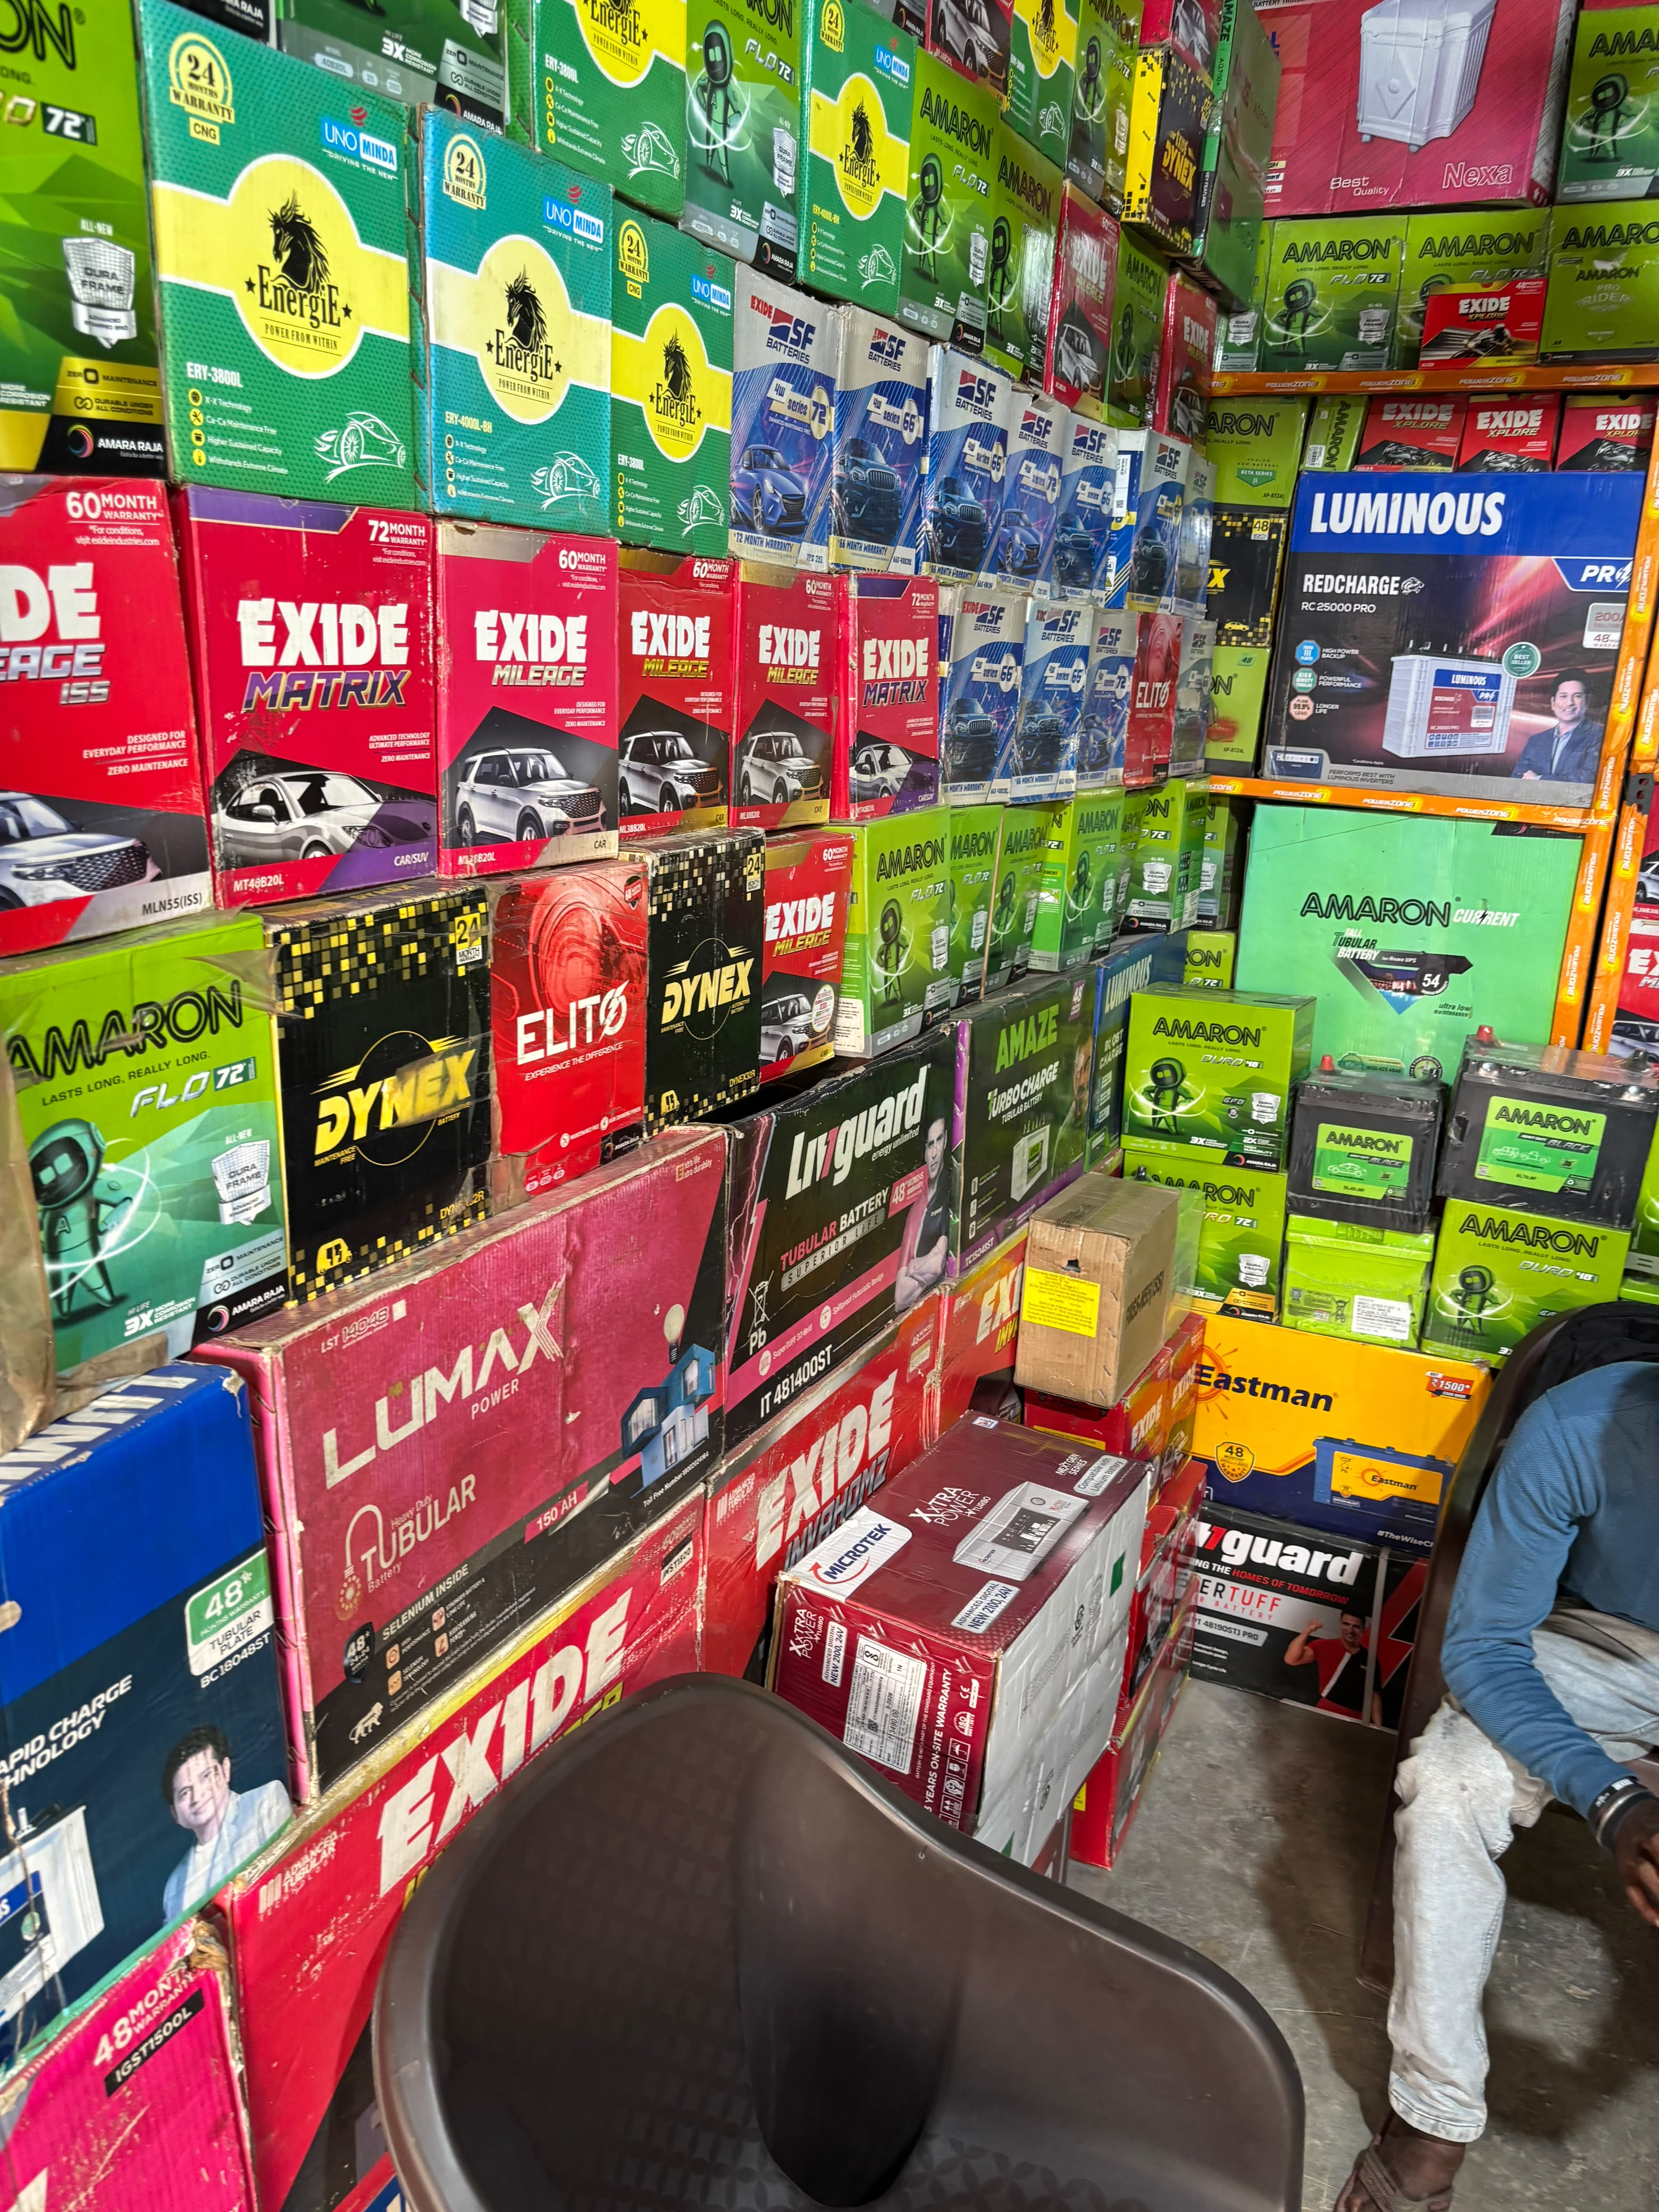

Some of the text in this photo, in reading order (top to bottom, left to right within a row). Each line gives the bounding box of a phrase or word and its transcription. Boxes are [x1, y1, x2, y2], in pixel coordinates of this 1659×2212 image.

[187, 52, 215, 86] 24
[188, 80, 219, 99] MONTHS
[171, 88, 234, 122] WARRANTY
[193, 123, 217, 140] CNG
[920, 88, 992, 161] AMARON
[325, 123, 395, 166] UNO MINDA
[1330, 175, 1369, 190] Best
[1443, 163, 1513, 189] Nexa
[1353, 185, 1389, 197] Quality
[80, 220, 113, 236] ALL-NEW
[1283, 238, 1391, 264] AMARON
[81, 280, 125, 295] FRAME
[85, 266, 118, 282] DURA
[751, 295, 772, 319] EXIDE
[1459, 297, 1510, 315] EXIDE
[265, 324, 338, 350] POWER FROM WITHIN
[766, 338, 810, 364] BATTERIES
[103, 375, 157, 387] MAINTENANCE
[187, 362, 243, 389] ERY-3800L
[1459, 375, 1516, 385] POWERZONE
[975, 374, 996, 407] SF
[219, 397, 252, 414] Technology
[787, 398, 807, 416] series
[957, 397, 993, 420] BATTERIES
[226, 419, 263, 433] Maintenance
[265, 425, 277, 435] Free
[445, 411, 492, 434] ERY-4000L-BH
[1477, 409, 1543, 430] EXIDE
[1487, 426, 1538, 438] XPLORE
[98, 438, 163, 454] AMARA RAJA
[208, 435, 282, 456] Higher Sustained Capacity
[1323, 400, 1352, 468] AMARON
[208, 455, 288, 474] Withstands Extreme Climate
[66, 492, 156, 520] 60 MONTH
[1310, 492, 1506, 535] LUMINOUS
[106, 527, 144, 537] conditions,
[1254, 522, 1268, 531] 48
[91, 537, 160, 546] exideindustries.com
[744, 534, 793, 552] MONTH WARRANTY
[559, 549, 605, 569] 60 MONTH
[1303, 575, 1401, 595] REDCHARGE
[1302, 602, 1376, 614] RC 25000 PRO
[237, 599, 408, 666] EXIDE
[474, 609, 587, 663] EXIDE
[631, 611, 710, 658] EXIDE
[758, 625, 820, 667] EXIDE
[642, 659, 709, 678] MILEAGE
[862, 638, 928, 680] EXIDE
[491, 665, 586, 686] MILEAGE
[61, 681, 110, 705] ISS
[242, 671, 411, 711] MATRIX
[862, 680, 928, 707] MATRIX
[83, 740, 186, 759] EVERYDAY PERFORMANCE
[127, 731, 186, 744] DESIGNED FOR
[108, 759, 188, 775] ZERO MAINTENANCE
[1358, 776, 1394, 785] INVERTERS
[1363, 798, 1414, 808] POWERZONE
[594, 839, 606, 849] CAR
[394, 852, 429, 866] CAR/SUV
[876, 841, 944, 882] AMARON
[233, 875, 284, 892] MT40B20L
[142, 892, 202, 916] MLN55(ISS)
[765, 892, 835, 941] EXIDE
[1300, 892, 1451, 927] AMARON
[772, 930, 832, 957] MILEAGE
[1337, 948, 1380, 960] BATTERY
[661, 958, 755, 1024] DYNEX
[1104, 954, 1153, 1013] LUMINOUS
[1422, 974, 1440, 987] 54
[995, 1004, 1059, 1074] AMAZE
[1153, 1017, 1262, 1048] AMARON
[216, 1063, 243, 1087] 72
[525, 1042, 623, 1082] EXPERIENCE THE DIFFERENCE
[42, 1086, 83, 1106] LASTS
[127, 1061, 171, 1082] REALLY
[175, 1052, 211, 1069] LONG.
[730, 1069, 756, 1087] DYNEX32R
[314, 1049, 476, 1155] DYNEX
[1002, 1092, 1043, 1125] TUBULAR BATTERY
[314, 1145, 356, 1167] MAINTENANCE
[872, 1126, 919, 1161] energy unlimited
[1326, 1132, 1400, 1153] AMARON
[340, 1153, 356, 1165] FREE
[1369, 1158, 1402, 1167] BLACK
[780, 1186, 889, 1271] TUBULAR BATTERY
[1459, 1214, 1598, 1258] AMARON
[749, 1328, 766, 1356] Pb
[322, 1273, 565, 1489] LUMAX
[760, 1344, 833, 1418] IT 481400ST
[1196, 1364, 1333, 1412] Eastman
[471, 1379, 520, 1420] POWER
[1225, 1446, 1243, 1457] 48
[756, 1368, 898, 1571] EXIDE
[537, 1492, 577, 1530] 150 AH
[934, 1490, 979, 1527] POWER
[346, 1474, 476, 1583] TUBULAR
[824, 1523, 892, 1579] MICROTEK
[367, 1562, 401, 1593] Battery
[1212, 1563, 1349, 1604] THE HOMES OF TOMORROW
[382, 1564, 468, 1640] SELENIUM INSIDE
[957, 1582, 1000, 1626] ADVANCED DIGITAL
[969, 1612, 987, 1629] NEW
[1000, 1586, 1013, 1604] 24V
[210, 1611, 261, 1650] TUBULAR
[220, 1628, 254, 1655] PLATE
[200, 1632, 271, 1689] BC18048ST
[0, 1674, 132, 1774] APID CHARGE
[925, 1669, 952, 1803] YEARS ON-SITE WARRANTY
[377, 1588, 633, 1898] EXIDE
[93, 2010, 133, 2066] 48
[114, 2007, 192, 2083] IGST1500L
